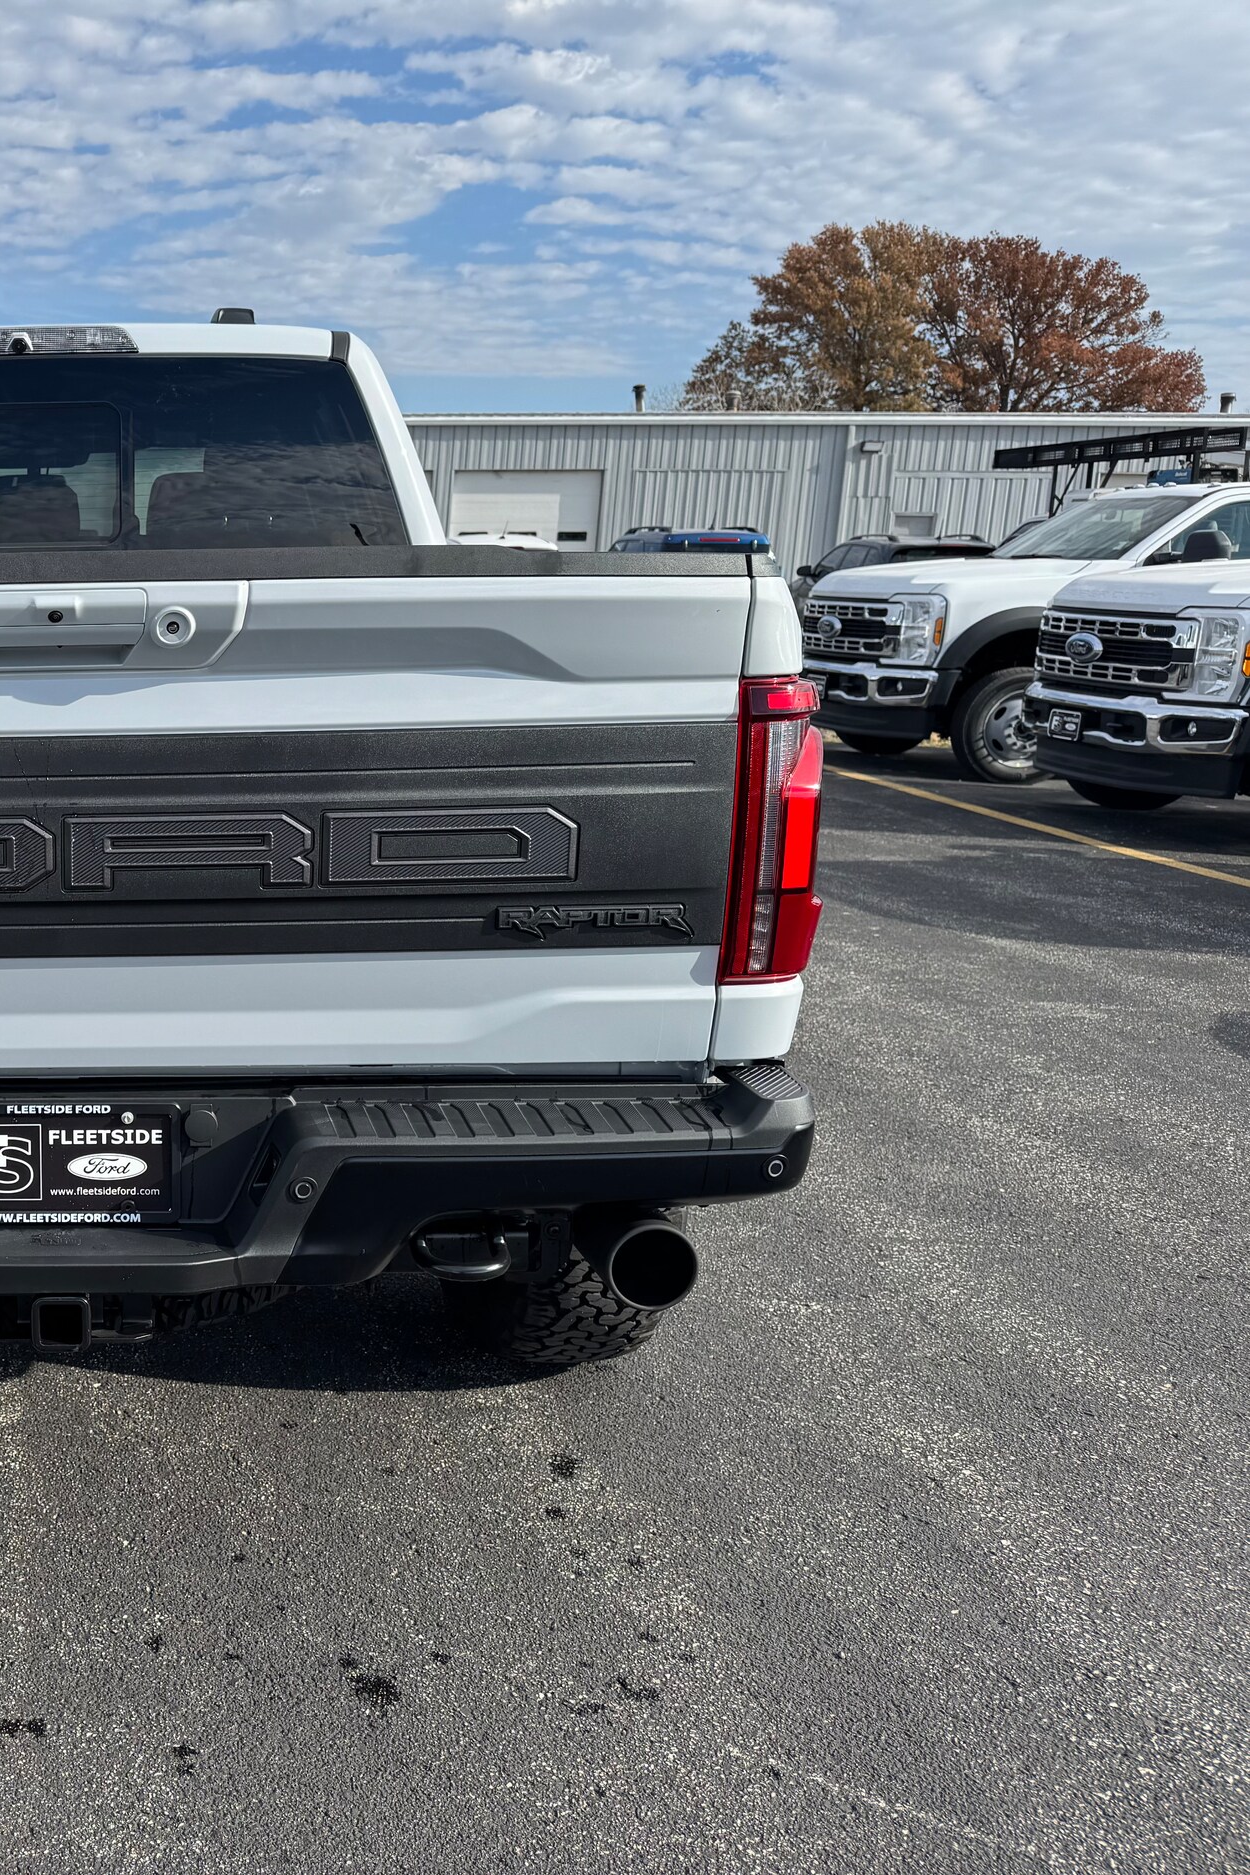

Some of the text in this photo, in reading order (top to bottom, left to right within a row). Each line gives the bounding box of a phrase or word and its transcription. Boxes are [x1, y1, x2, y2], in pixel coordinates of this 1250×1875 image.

[495, 903, 694, 941] RAPTOR
[6, 1105, 111, 1114] FLEETSIDE FORD
[48, 1129, 163, 1145] FLEETSIDE
[83, 1157, 130, 1174] Ford
[50, 1186, 160, 1196] www.fleetsideford.com
